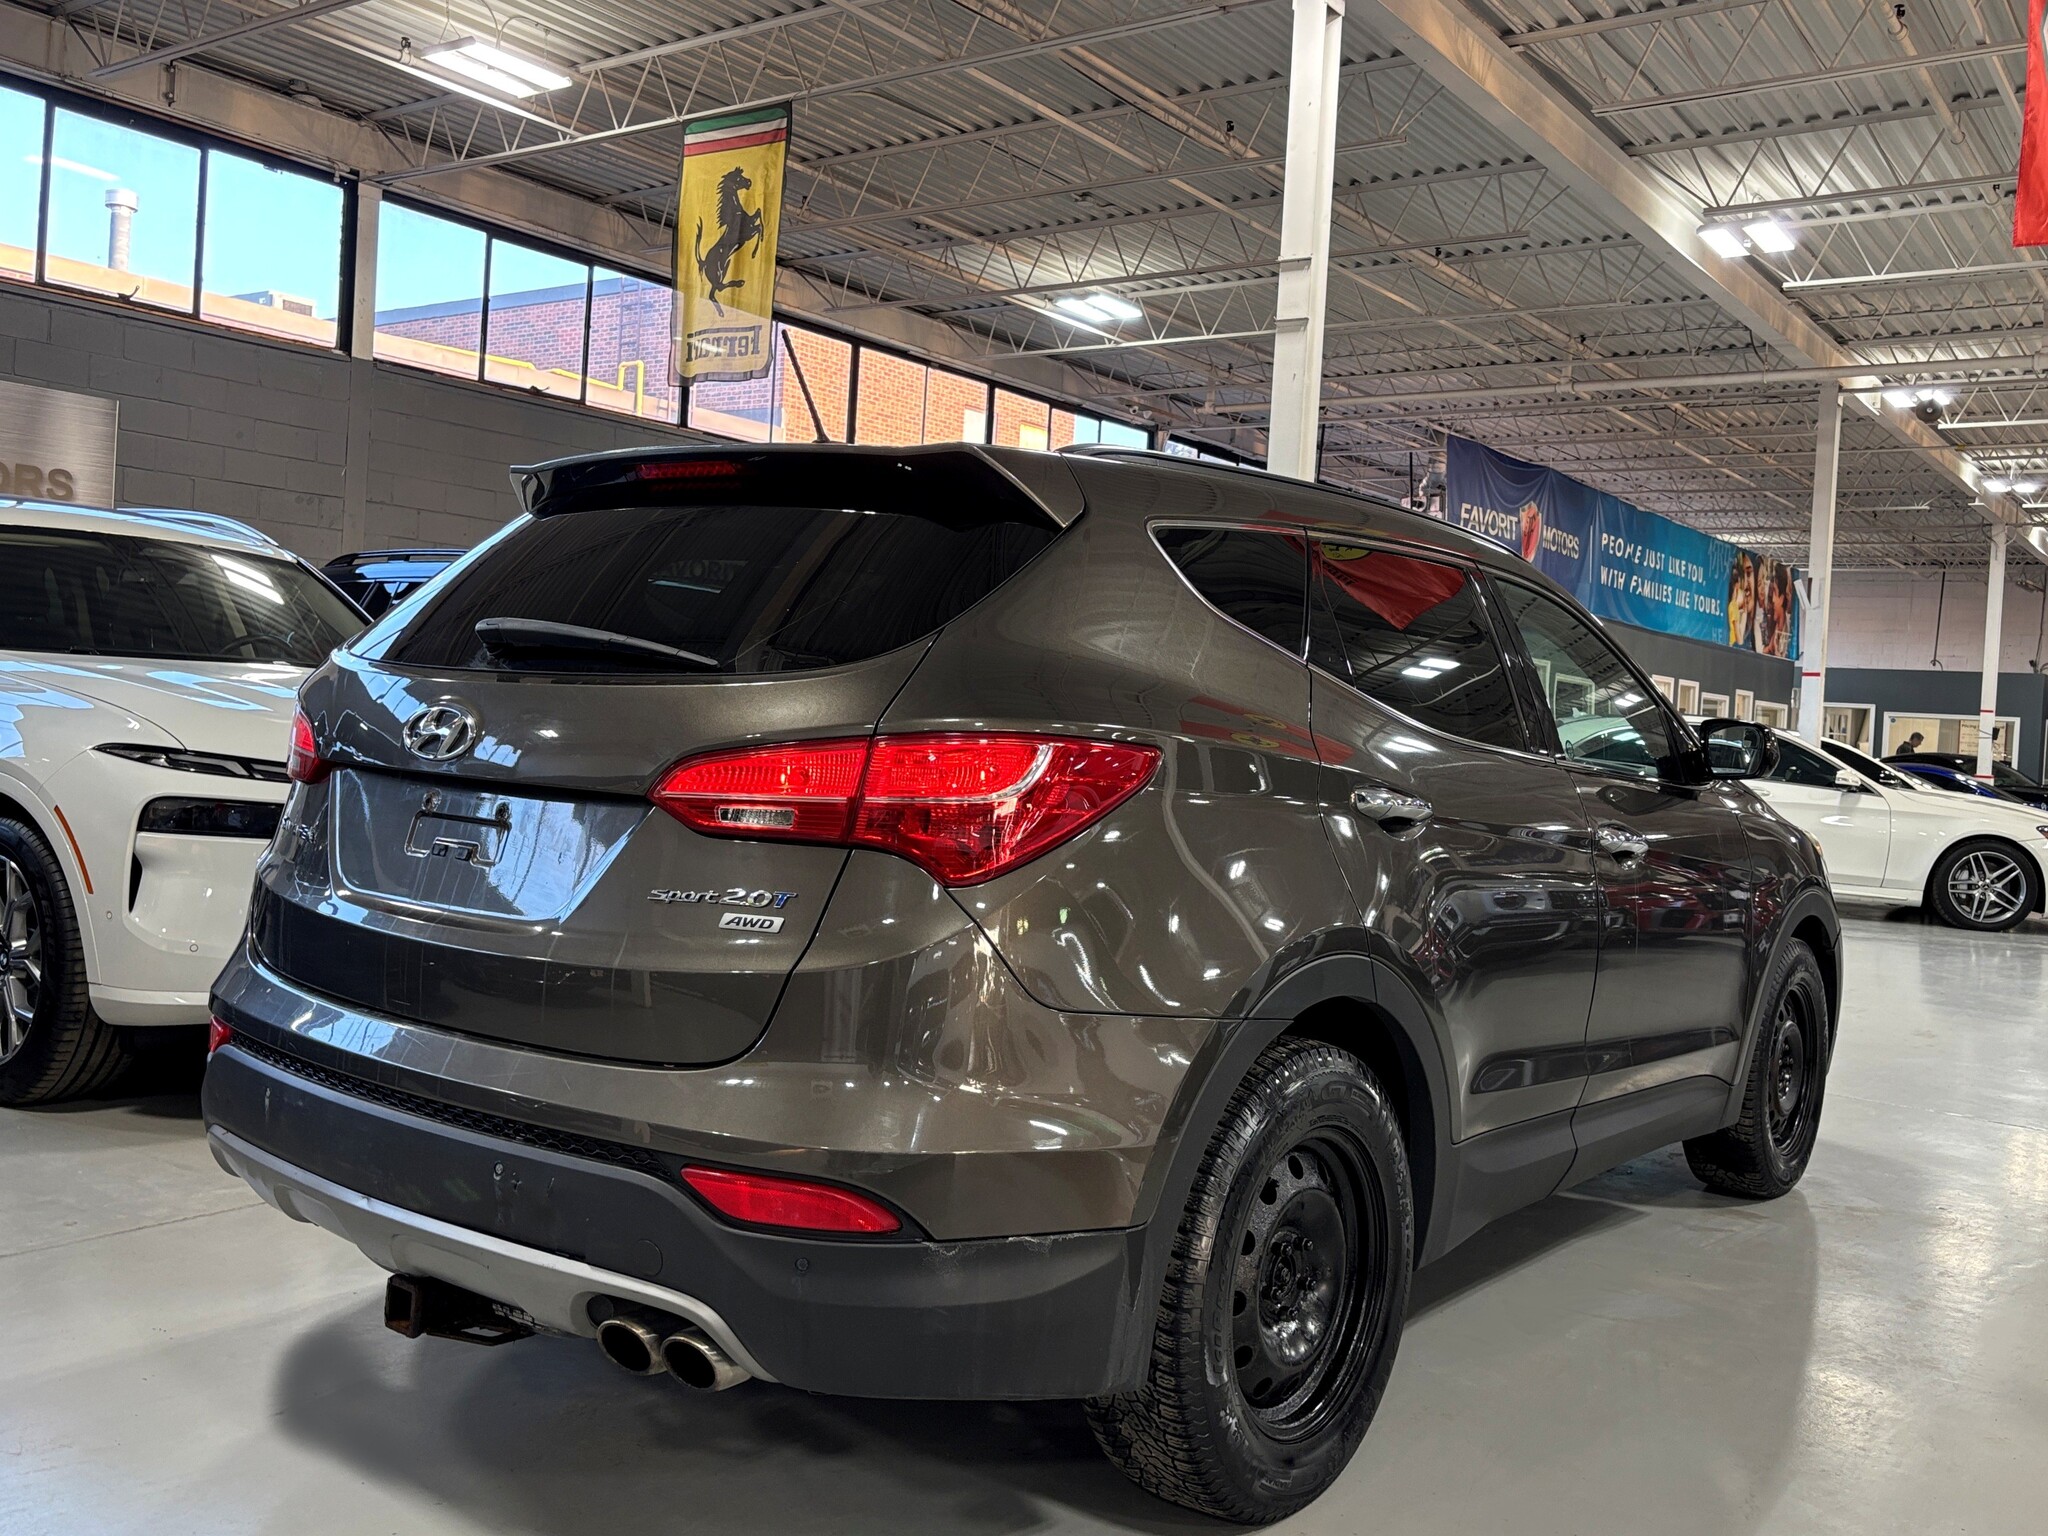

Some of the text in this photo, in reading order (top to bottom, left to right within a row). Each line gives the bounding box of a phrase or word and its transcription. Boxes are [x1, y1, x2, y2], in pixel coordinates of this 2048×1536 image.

[1460, 503, 1518, 540] FAVORIT
[1543, 524, 1580, 559] MOTORS
[1643, 548, 1665, 571] JUST
[1668, 556, 1687, 578] LIKE
[1688, 562, 1706, 586] YOU,
[1601, 565, 1724, 617] WITH FAMILIES LIKE YOURS.
[725, 916, 775, 930] AWD
